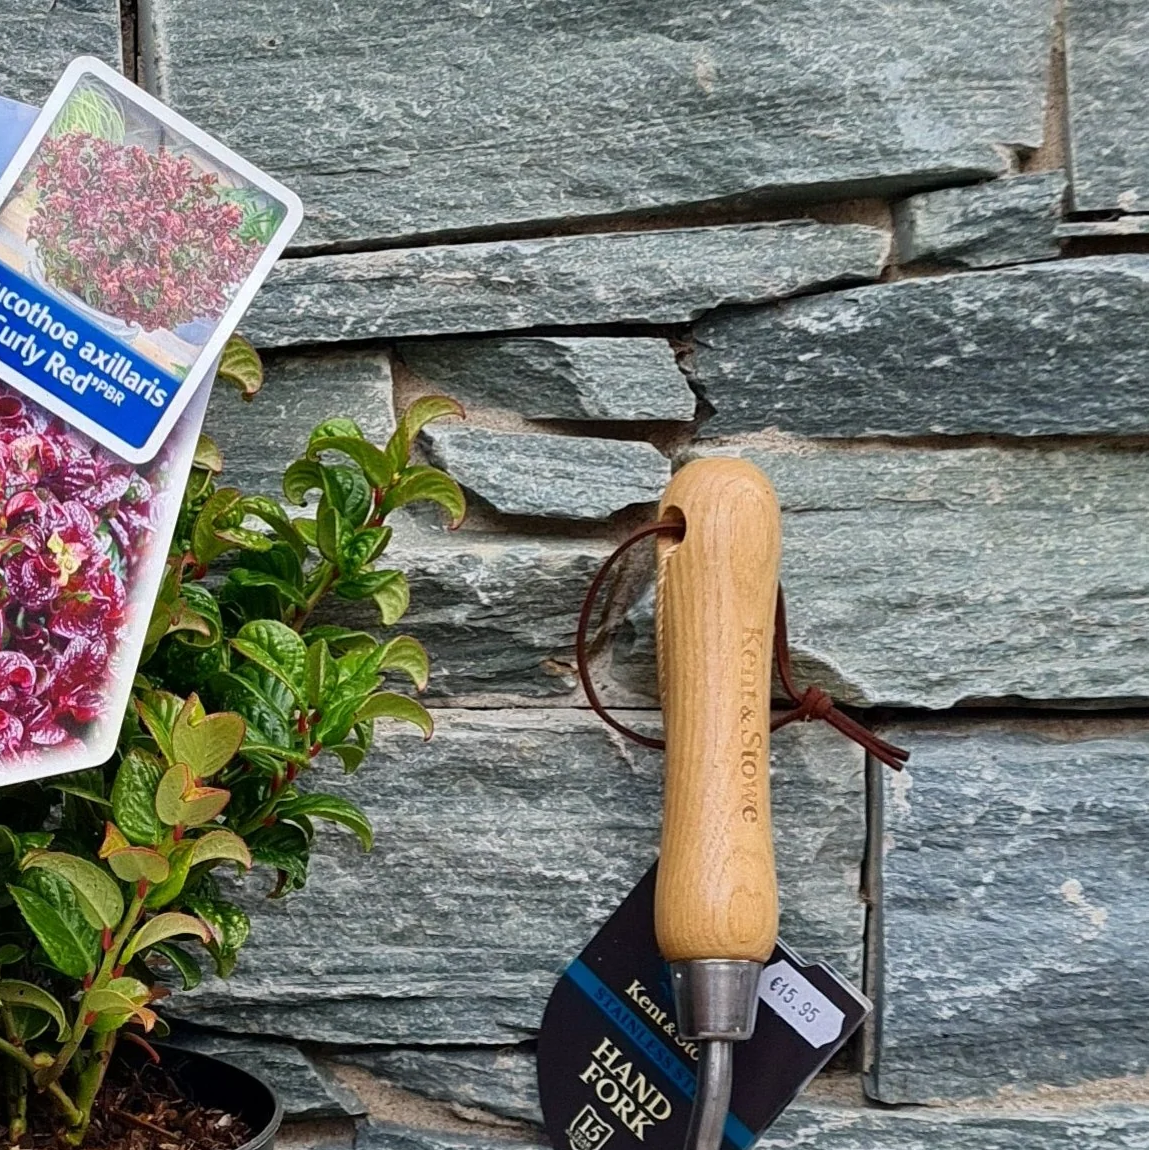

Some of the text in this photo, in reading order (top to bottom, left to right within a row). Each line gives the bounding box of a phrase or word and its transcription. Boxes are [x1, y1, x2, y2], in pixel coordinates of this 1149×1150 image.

[78, 338, 169, 408] axillaris
[739, 626, 764, 824] Kent & Stowe
[593, 985, 673, 1070] STAINLESS
[624, 978, 676, 1037] Kent &
[769, 975, 821, 1024] €15.95
[578, 1060, 656, 1142] FORK
[591, 1036, 672, 1122] HAND
[578, 1115, 605, 1142] 15
